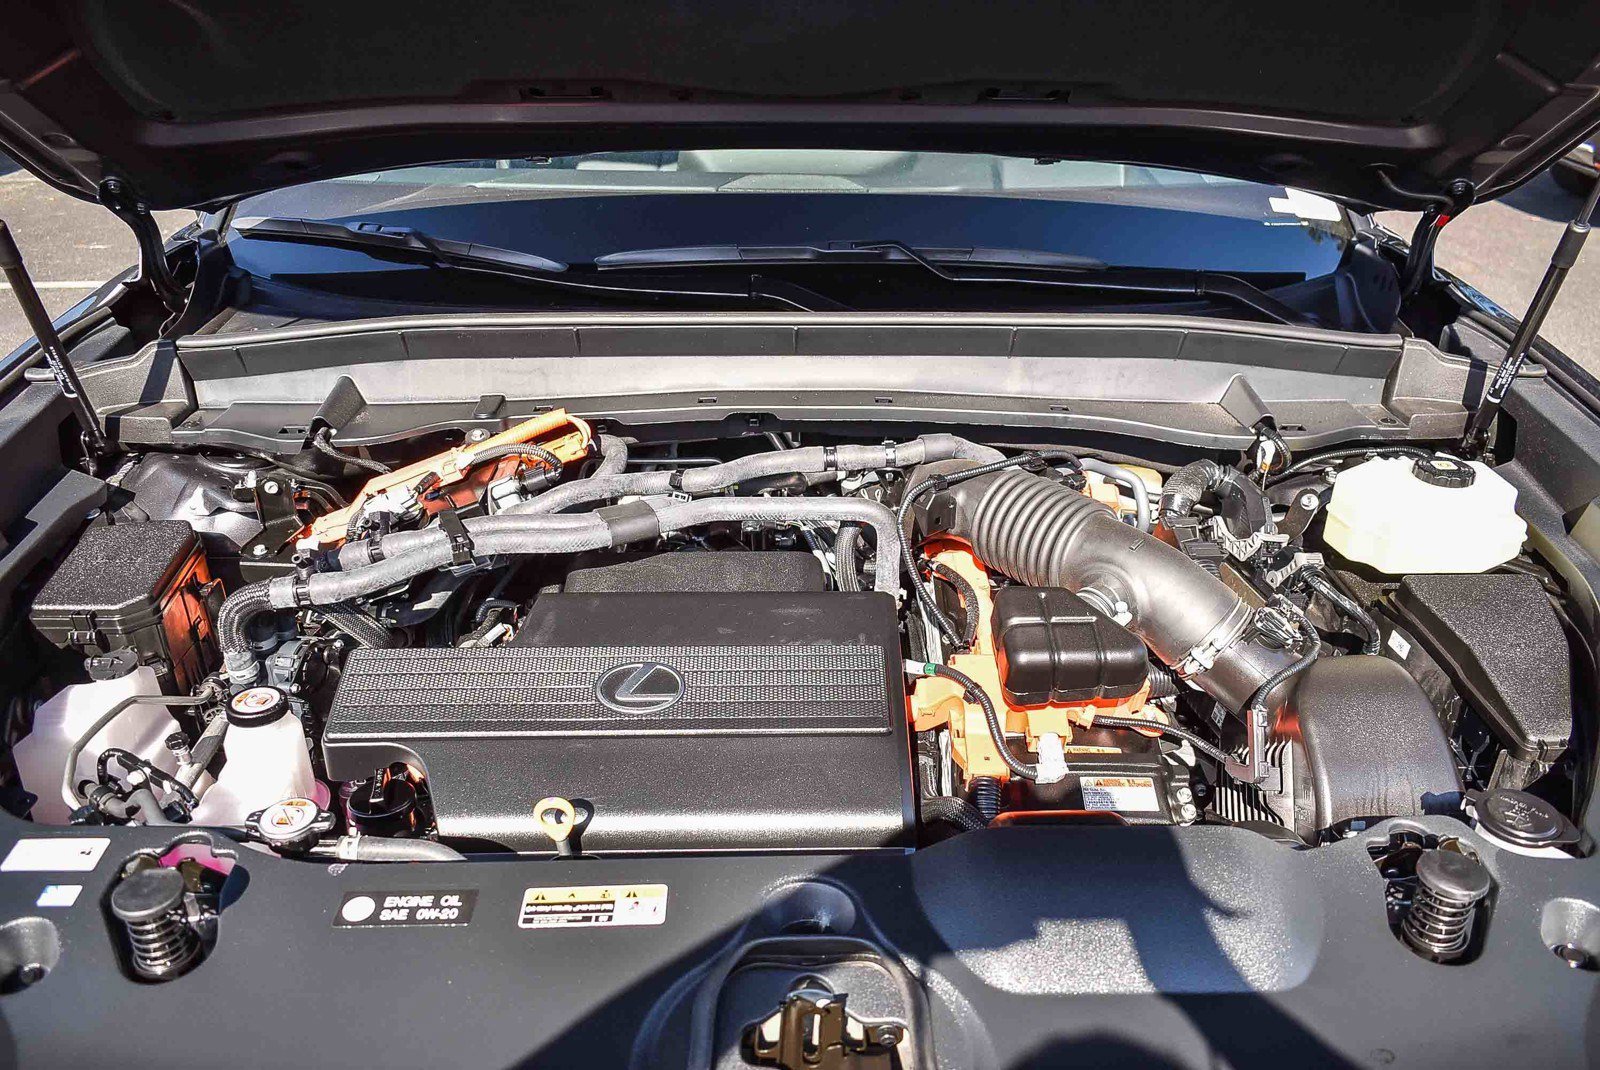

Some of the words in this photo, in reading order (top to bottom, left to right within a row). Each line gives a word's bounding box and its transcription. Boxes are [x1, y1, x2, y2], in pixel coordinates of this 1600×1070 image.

[383, 895, 435, 908] ENGINE
[440, 894, 463, 907] OIL
[379, 908, 410, 921] SAE
